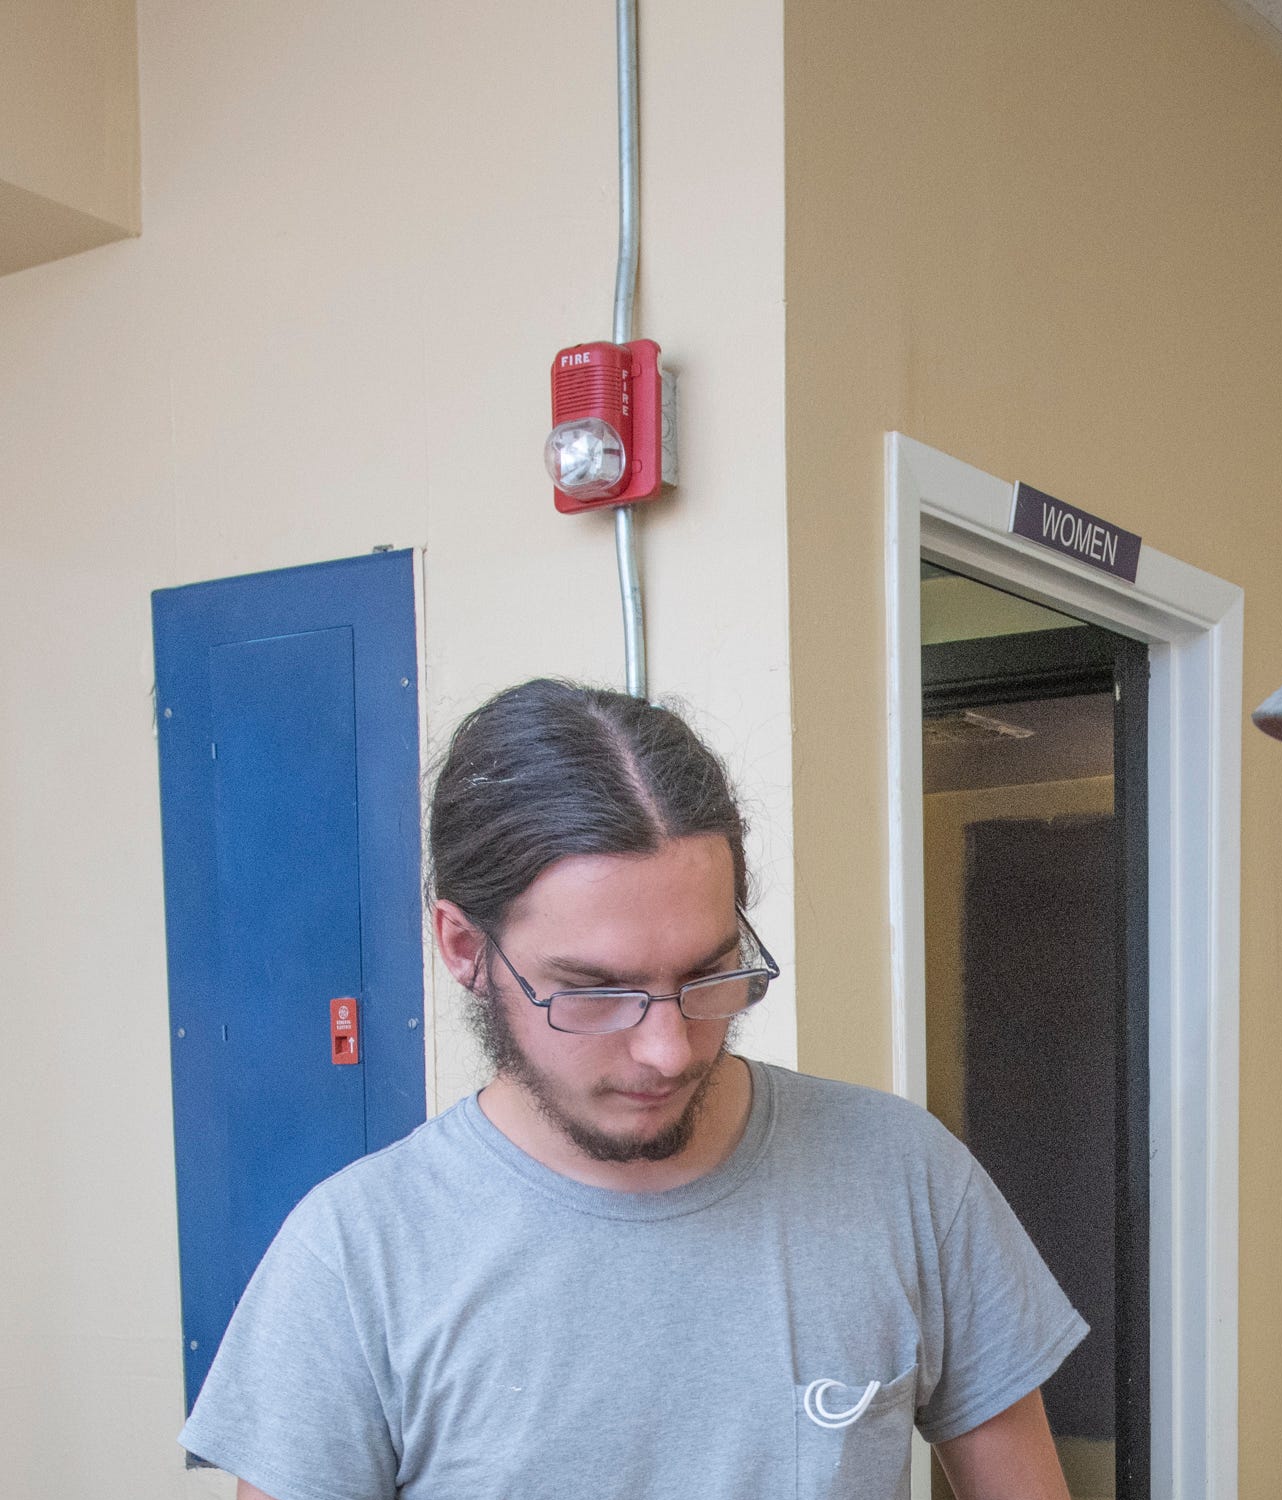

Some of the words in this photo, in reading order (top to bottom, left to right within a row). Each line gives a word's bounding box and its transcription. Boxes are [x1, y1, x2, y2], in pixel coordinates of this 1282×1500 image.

[561, 352, 590, 367] FIRE
[621, 370, 629, 416] FIRE
[1042, 502, 1118, 566] WOMEN
